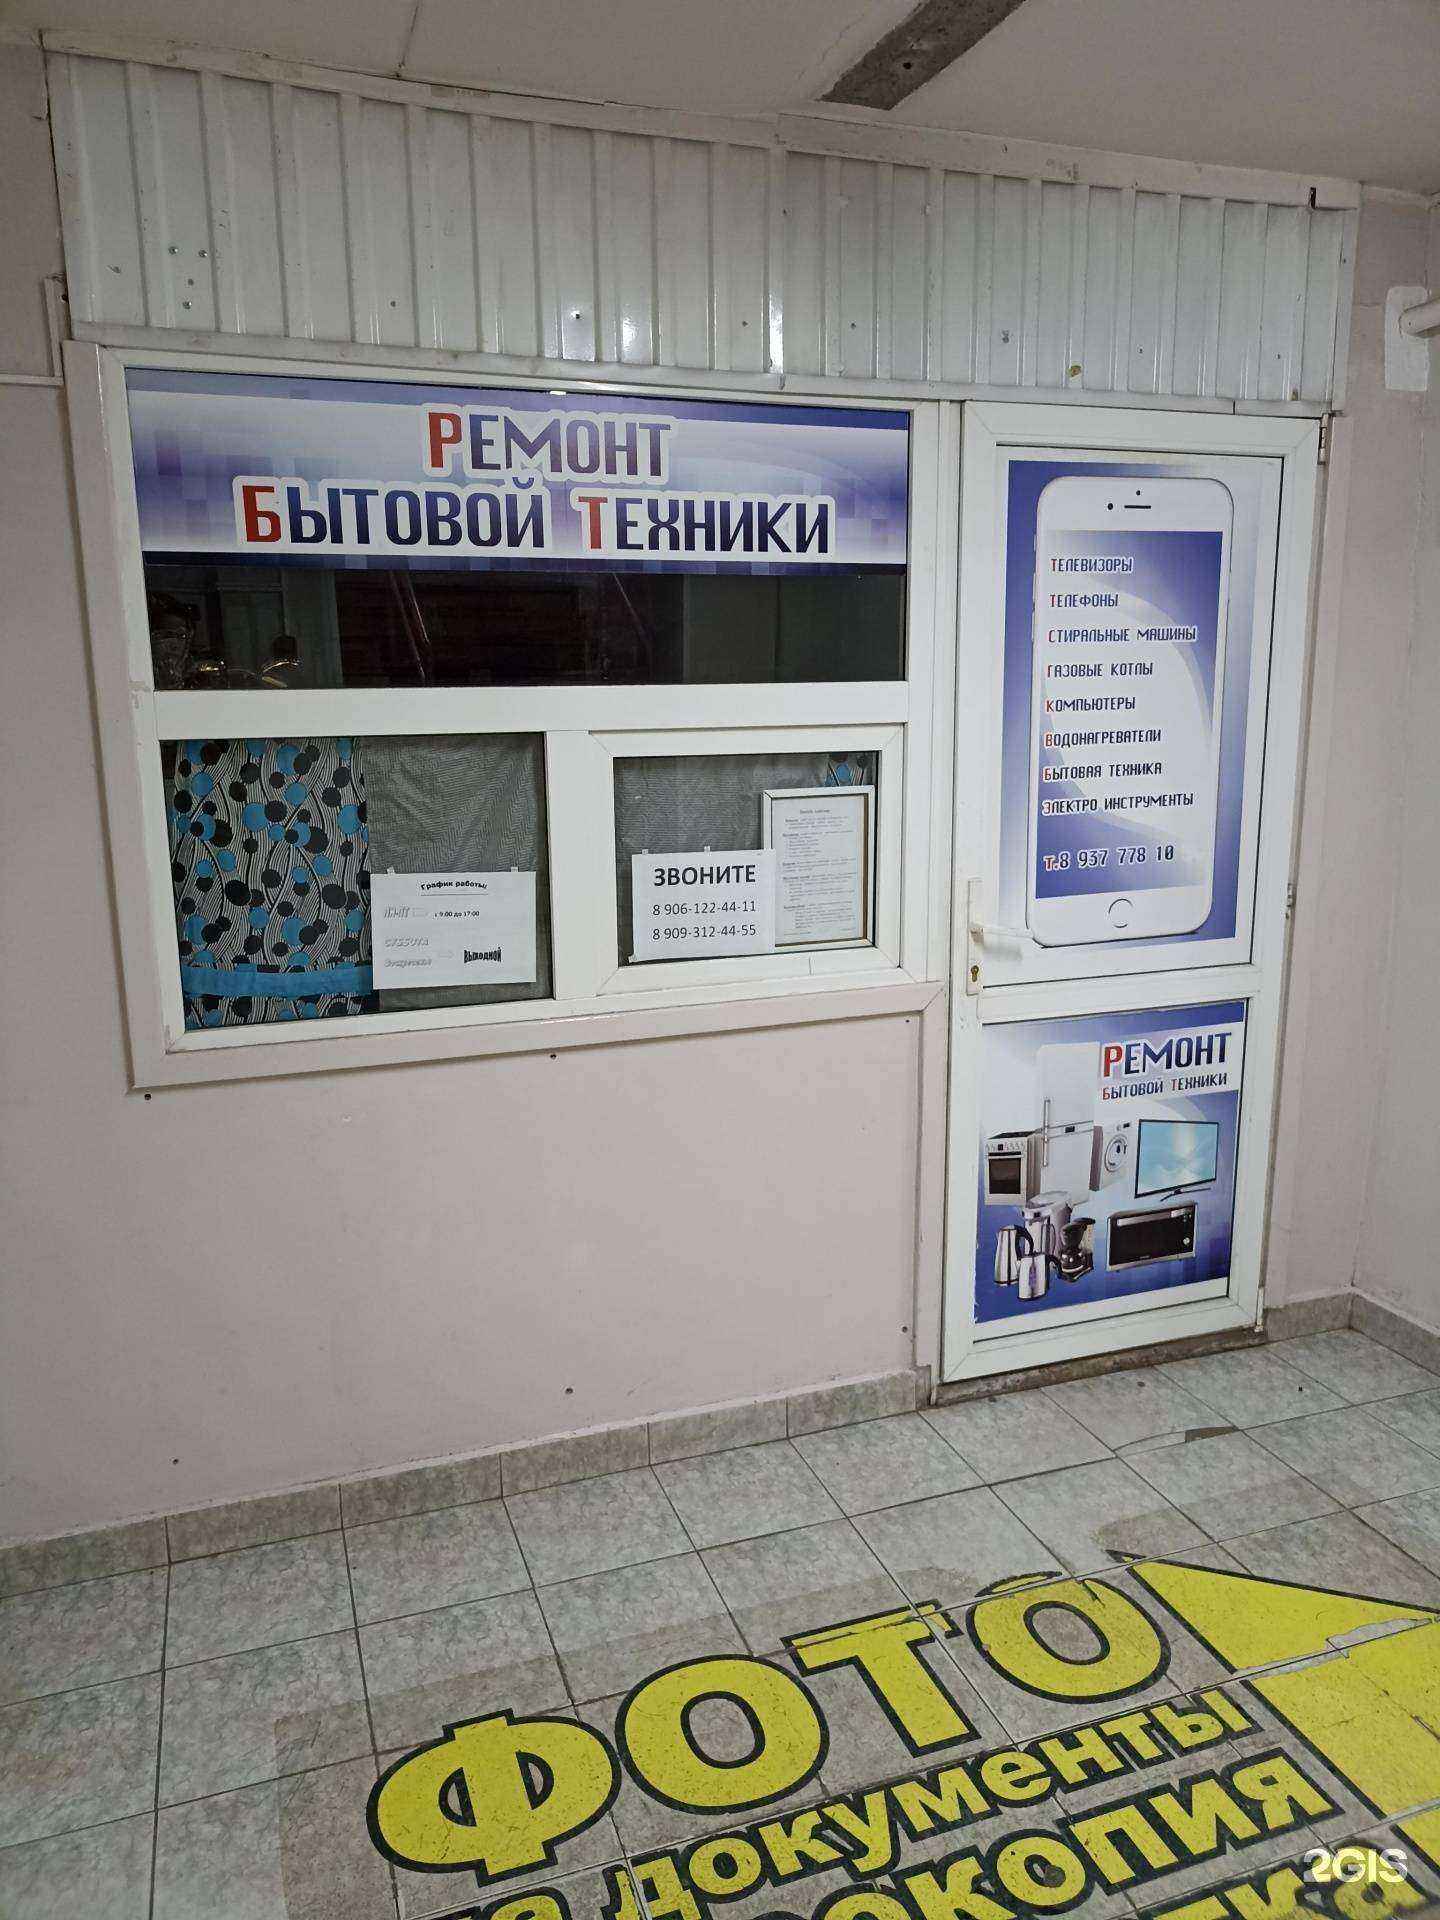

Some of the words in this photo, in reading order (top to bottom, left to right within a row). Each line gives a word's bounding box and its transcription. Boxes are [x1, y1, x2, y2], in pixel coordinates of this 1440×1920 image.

[428, 411, 671, 476] РЕМОНТ
[242, 476, 544, 548] БЫТОВОЙ
[577, 495, 830, 554] ТЕХНИКИ
[1051, 558, 1133, 573] ТЕЛЕВИЗОРЫ
[1050, 594, 1119, 608] ТЕЛЕФОНЫ
[1048, 629, 1131, 644] СТИРАЛЬНЫЕ
[1136, 627, 1197, 642] МАШИНЫ
[1047, 664, 1104, 678] ГАЗОВЫЕ
[1110, 662, 1154, 677] КОТЛЫ
[1046, 697, 1136, 713] КОМПЬЮТЕРЫ
[1045, 729, 1162, 748] ВОДОНАГРЕВАТЕЛИ
[1044, 766, 1102, 782] БЫТОВАЯ
[1109, 763, 1163, 778] ТЕХНИКА
[1042, 798, 1098, 815] ЭЛЕКТРО
[1104, 793, 1194, 811] ИНСТРУМЕНТЫ
[1078, 850, 1109, 868] 937
[1118, 847, 1146, 864] 778
[1155, 845, 1174, 862] 10
[420, 880, 454, 891] График
[653, 864, 756, 888] ЗВОНИТЕ
[652, 904, 661, 916] 8
[664, 900, 757, 916] 906-122-44-11
[652, 928, 661, 941] 8
[664, 924, 757, 940] 909-312-44-55
[1103, 1032, 1233, 1077] РЕМОНТ
[1102, 1078, 1164, 1101] БЫТОВОЙ
[1170, 1073, 1228, 1092] ТЕХНИКИ
[366, 1572, 1172, 1881] ФОТО
